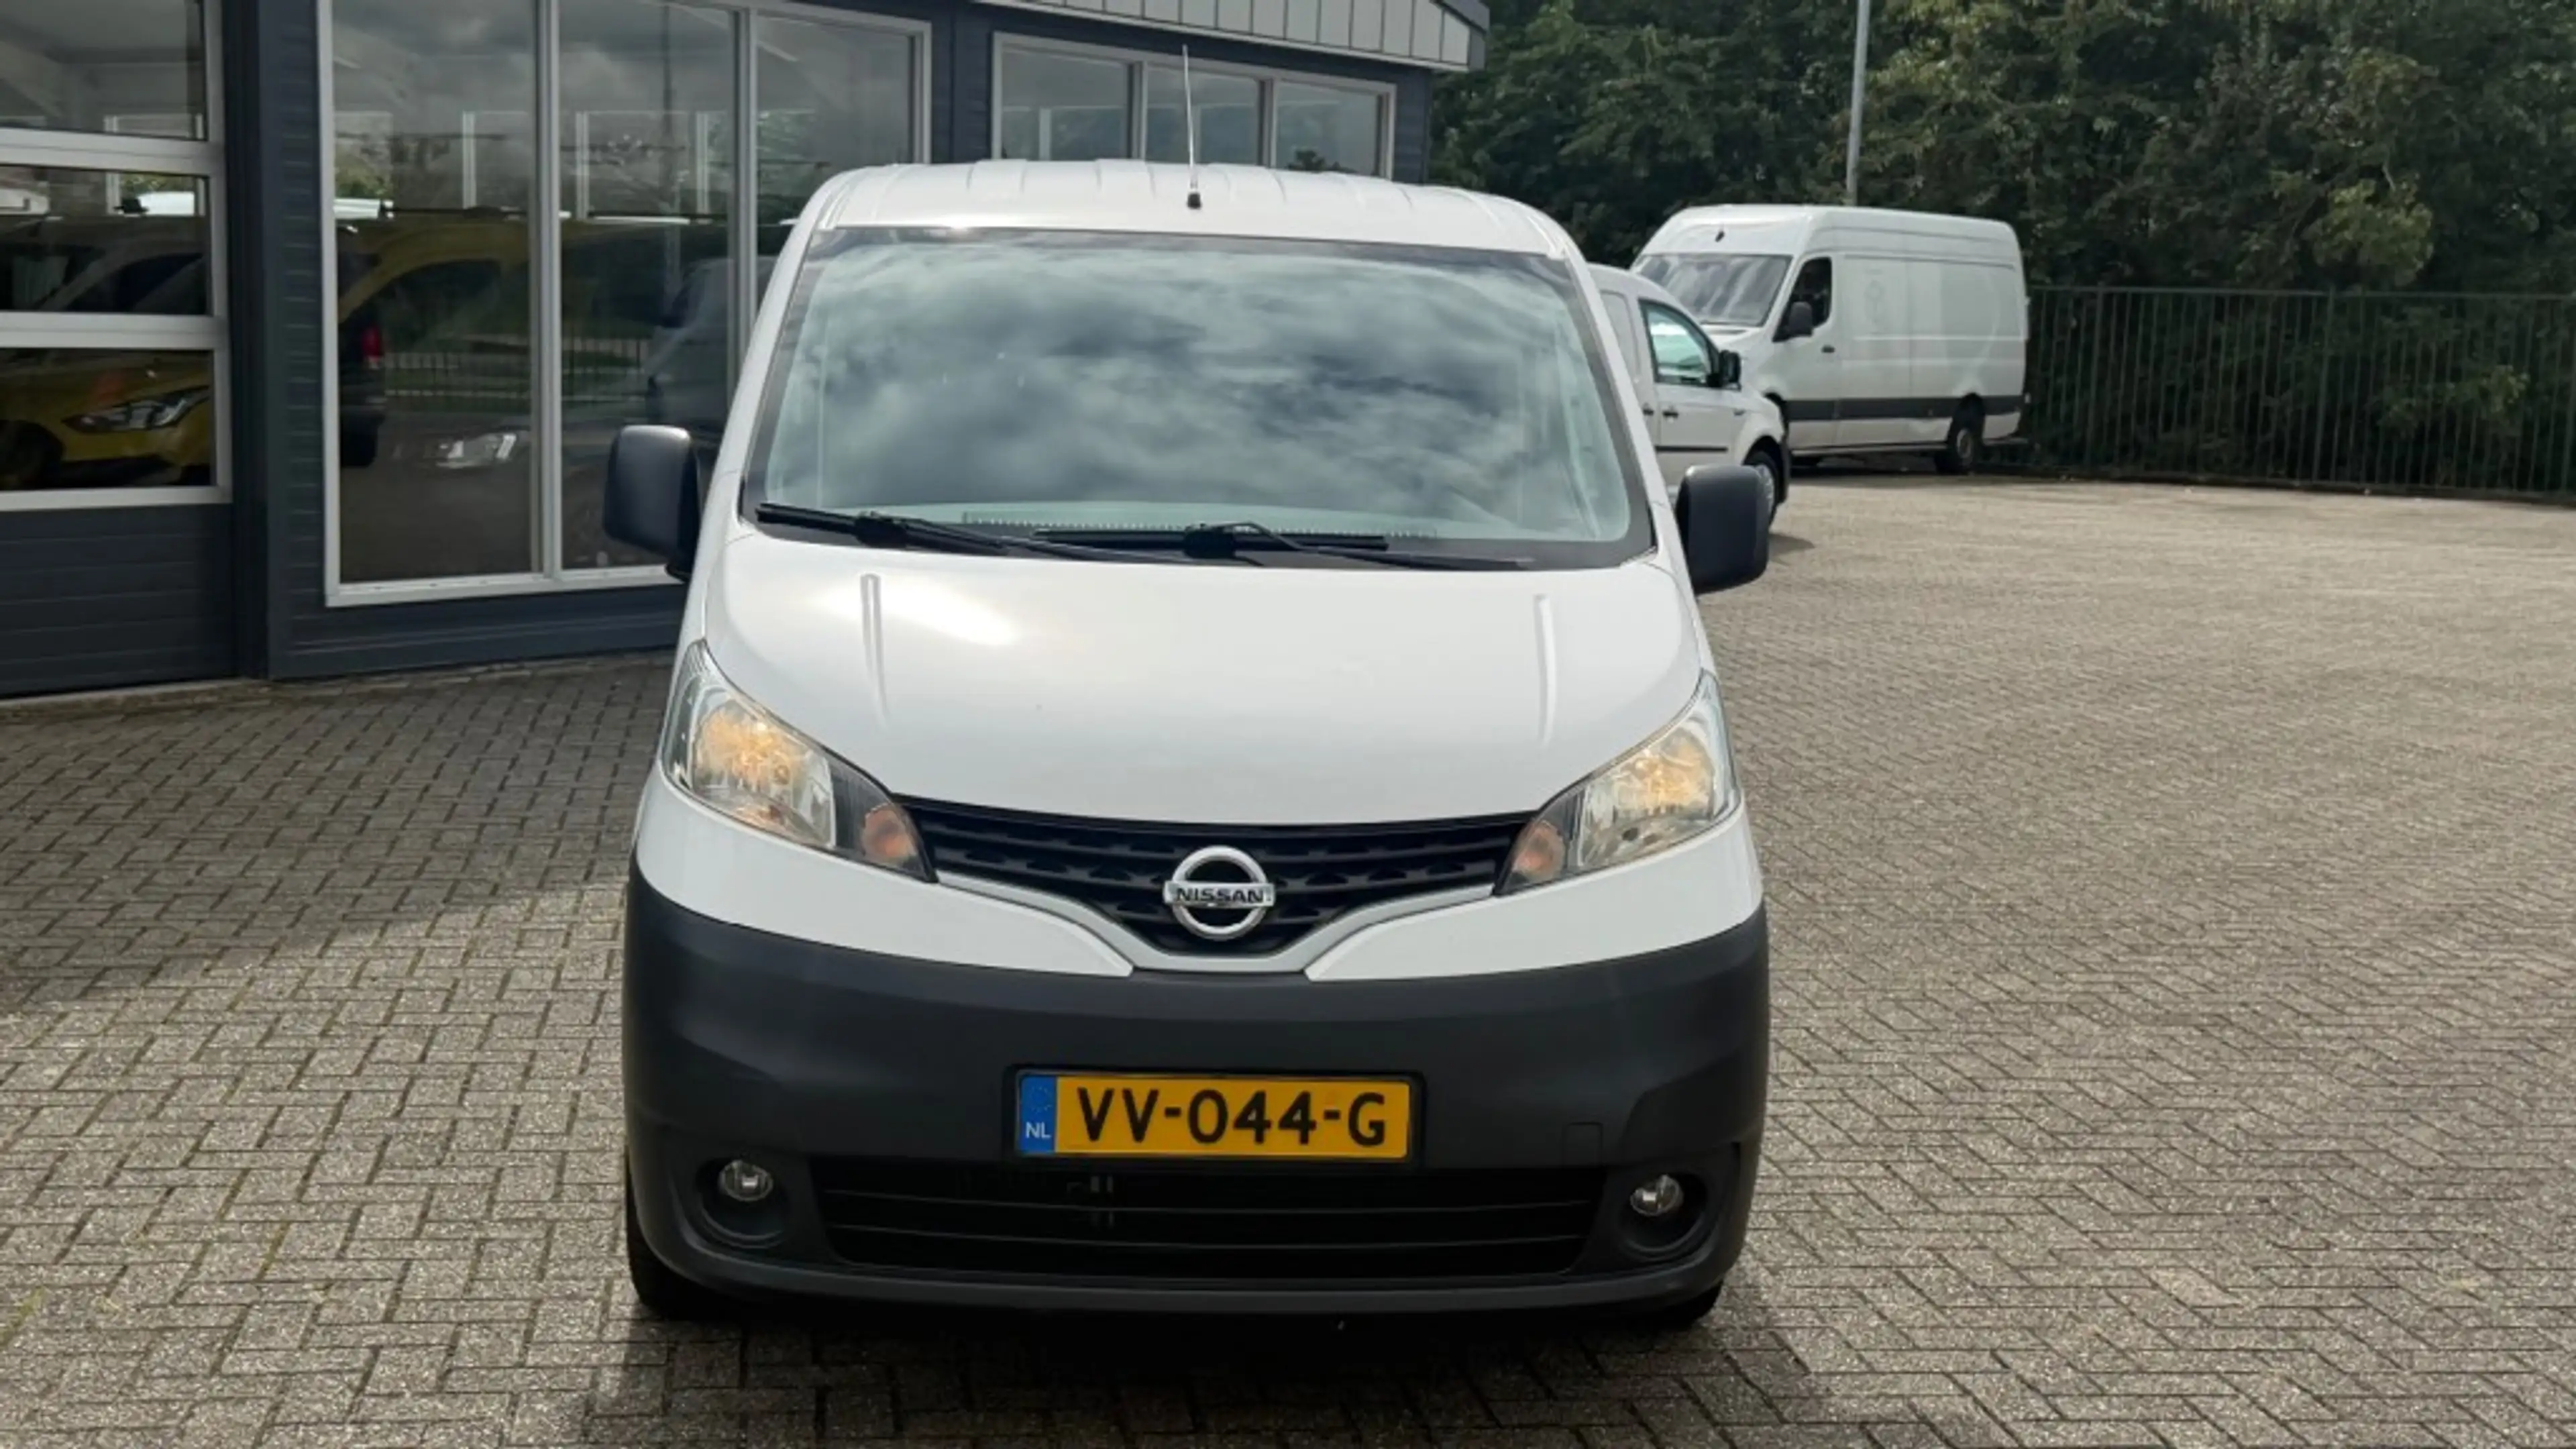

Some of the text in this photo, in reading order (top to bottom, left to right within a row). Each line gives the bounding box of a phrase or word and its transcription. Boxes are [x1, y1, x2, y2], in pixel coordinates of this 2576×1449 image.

[1177, 888, 1264, 902] NISSAN
[1077, 1087, 1386, 1147] VV-044-G
[1026, 1122, 1051, 1139] NL
